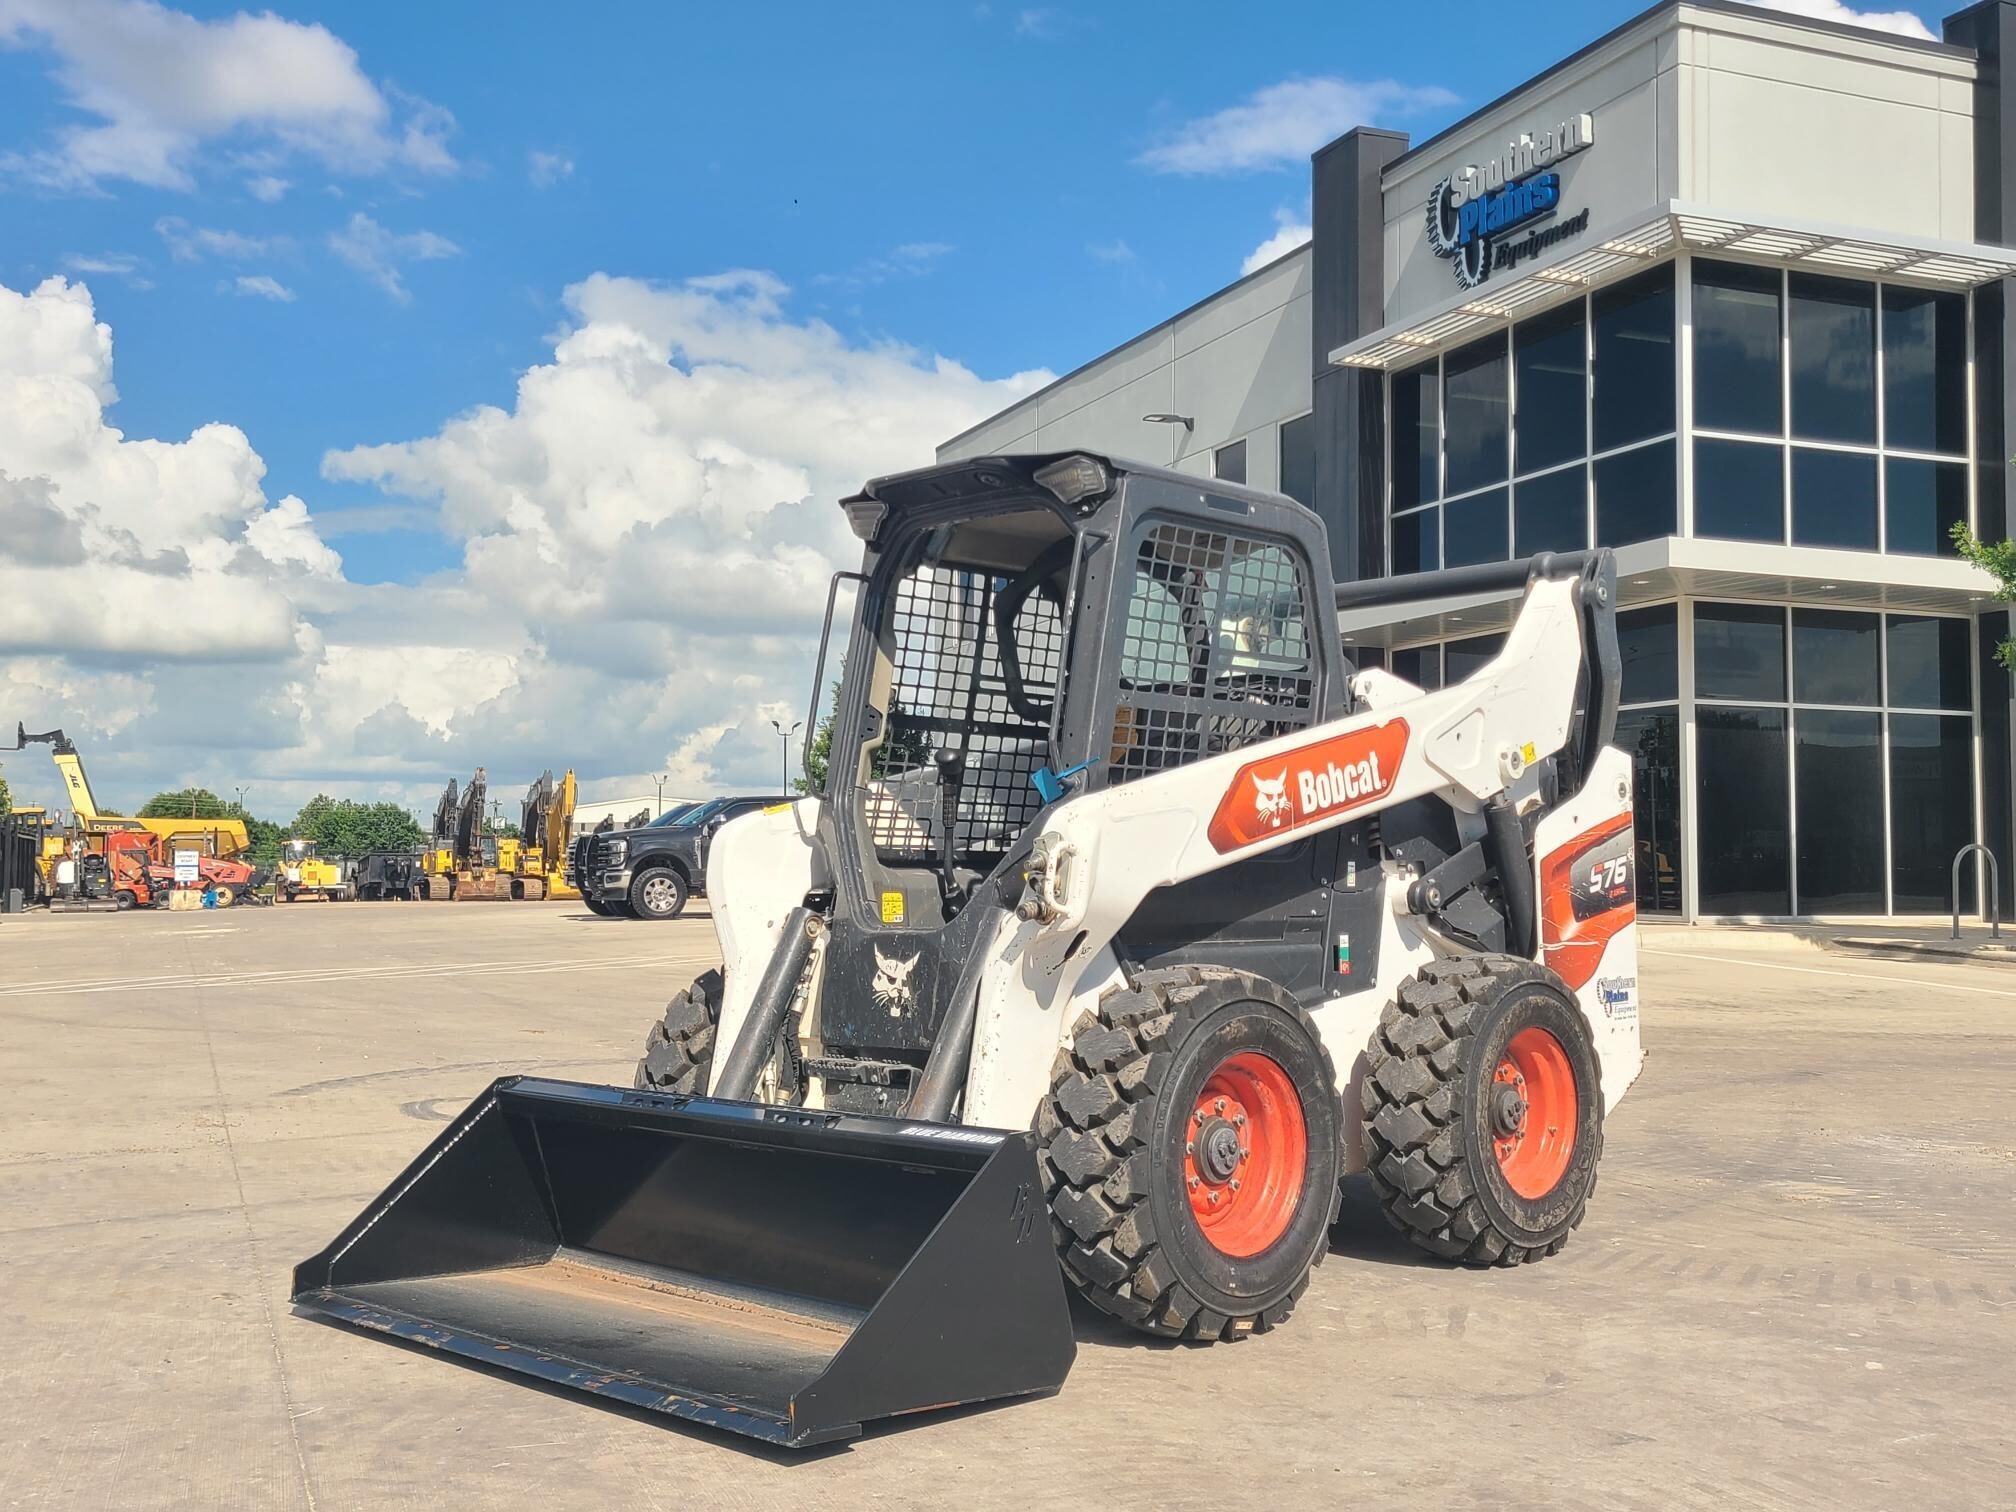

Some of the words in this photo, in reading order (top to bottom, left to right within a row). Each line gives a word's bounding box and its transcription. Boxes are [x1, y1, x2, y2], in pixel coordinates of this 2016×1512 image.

[1450, 113, 1594, 209] Southern
[1458, 172, 1561, 247] Plains
[1493, 207, 1590, 271] Equipment
[1297, 750, 1383, 815] Bobcat
[93, 823, 125, 832] DEERE
[1589, 855, 1628, 894] S76
